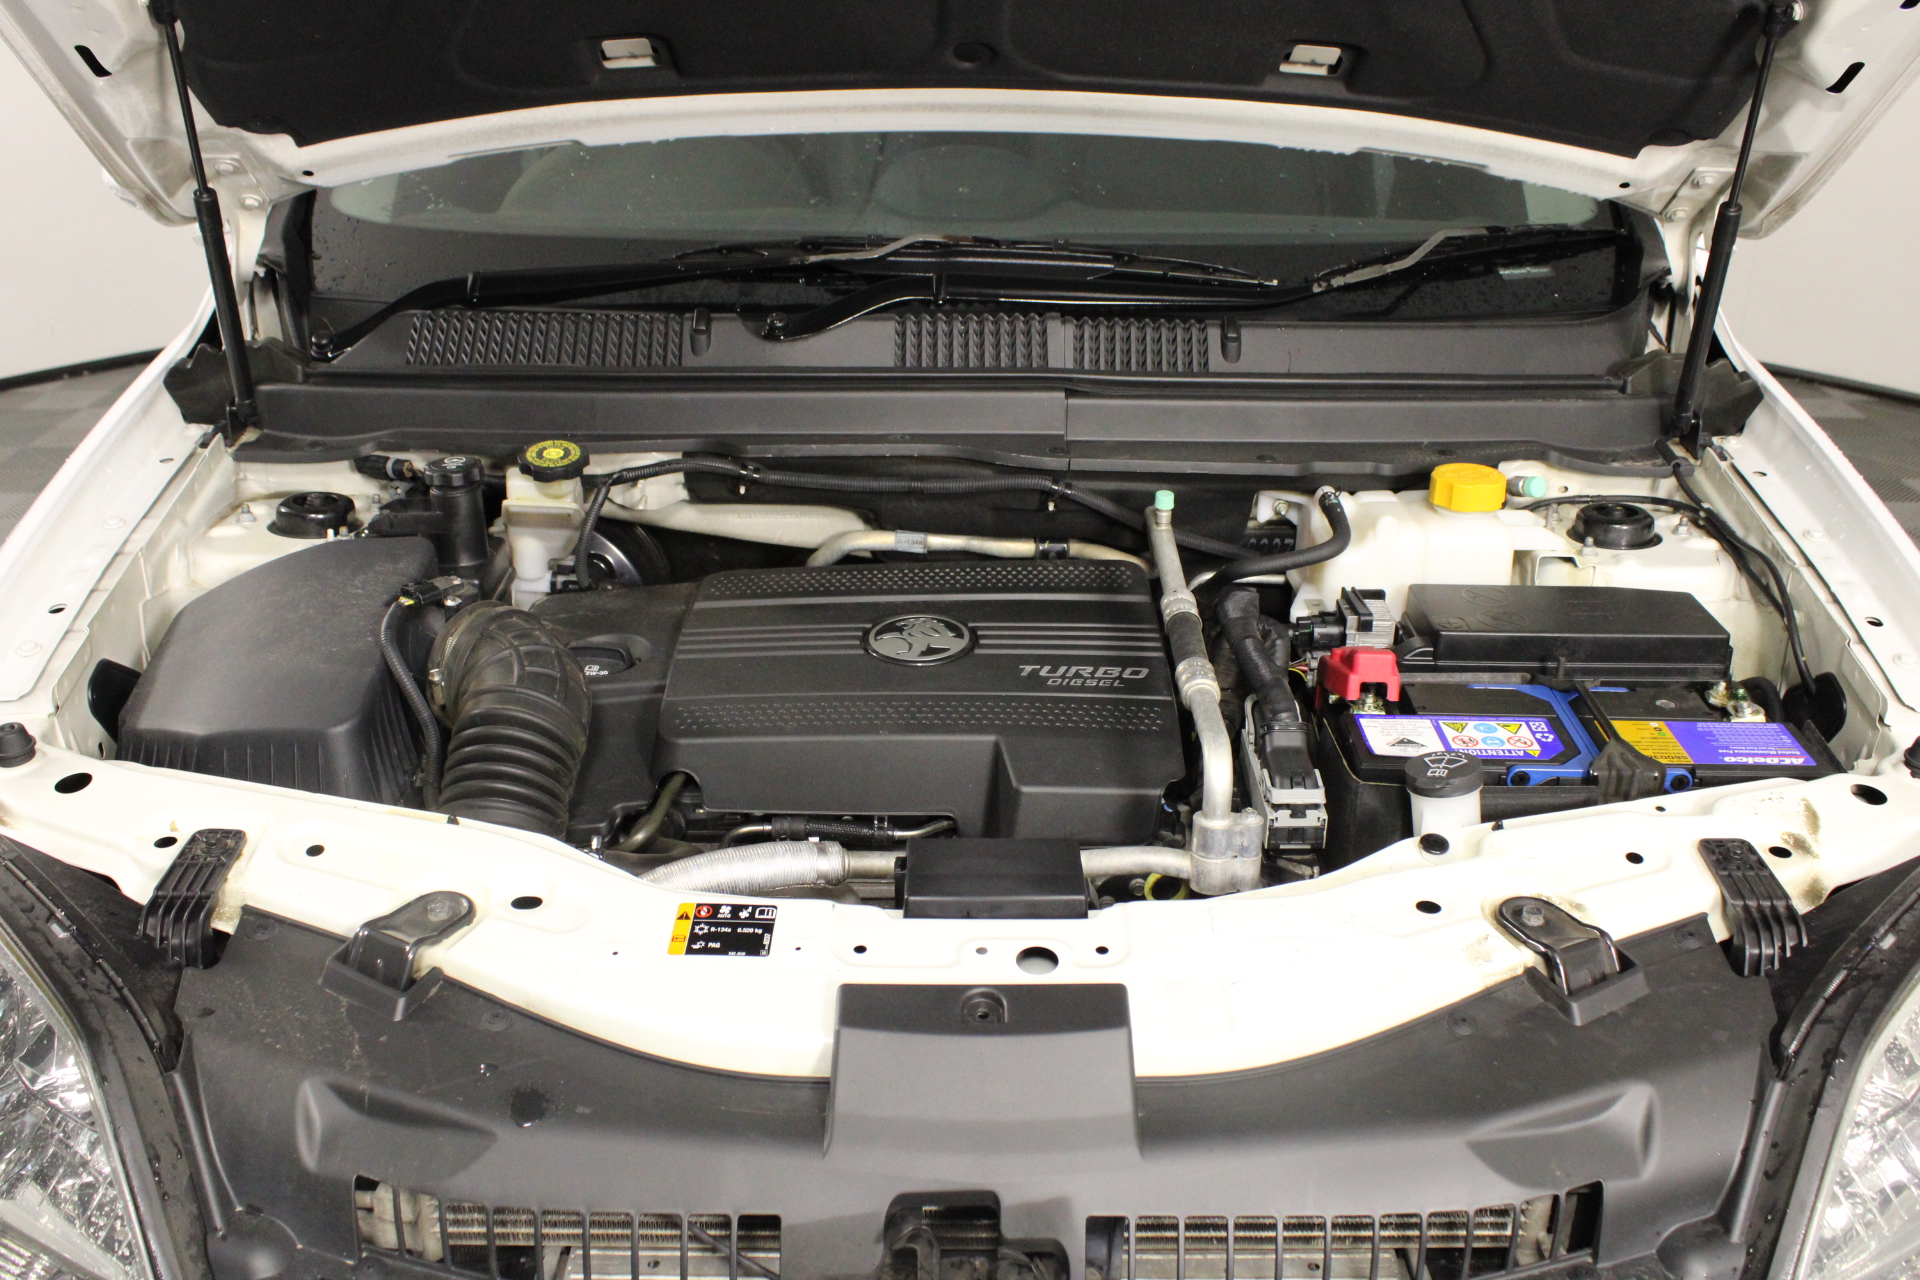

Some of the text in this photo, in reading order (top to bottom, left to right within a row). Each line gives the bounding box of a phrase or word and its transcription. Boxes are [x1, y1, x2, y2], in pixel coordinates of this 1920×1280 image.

[1019, 665, 1150, 679] TURBO
[1046, 678, 1125, 687] DIESEL
[1723, 756, 1805, 765] ACDelco
